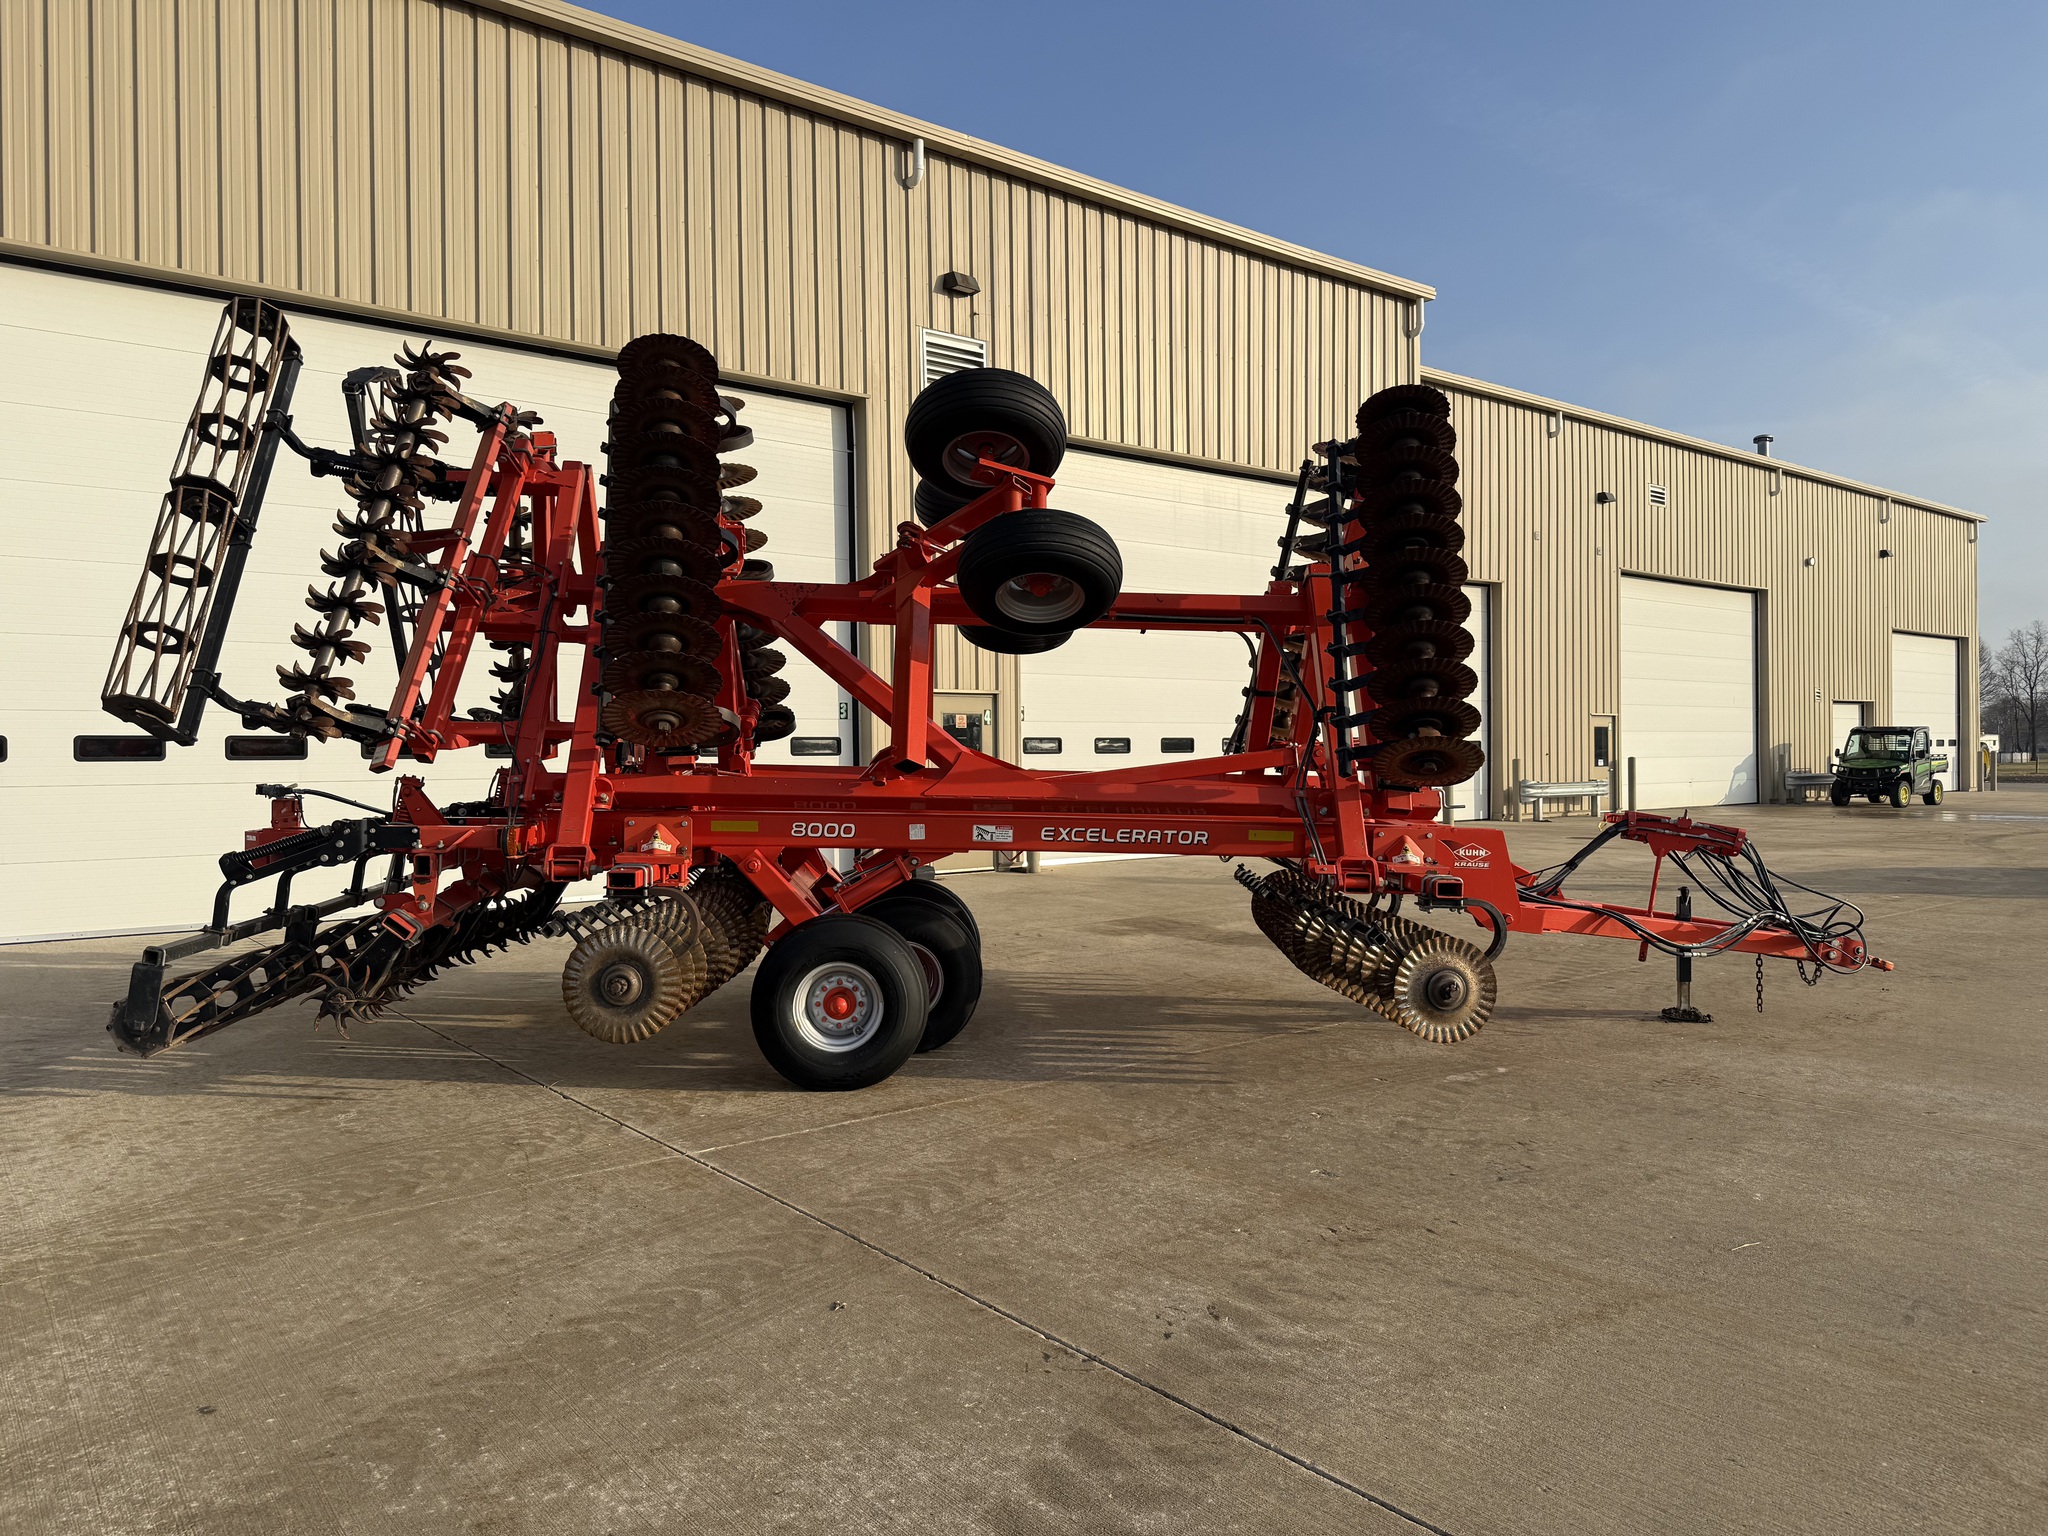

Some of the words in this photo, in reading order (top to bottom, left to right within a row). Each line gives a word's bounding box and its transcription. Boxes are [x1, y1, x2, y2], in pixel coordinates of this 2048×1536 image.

[840, 703, 847, 719] 3
[984, 709, 991, 725] 4
[791, 822, 857, 838] 8000
[1040, 826, 1209, 845] EXCELERATOR
